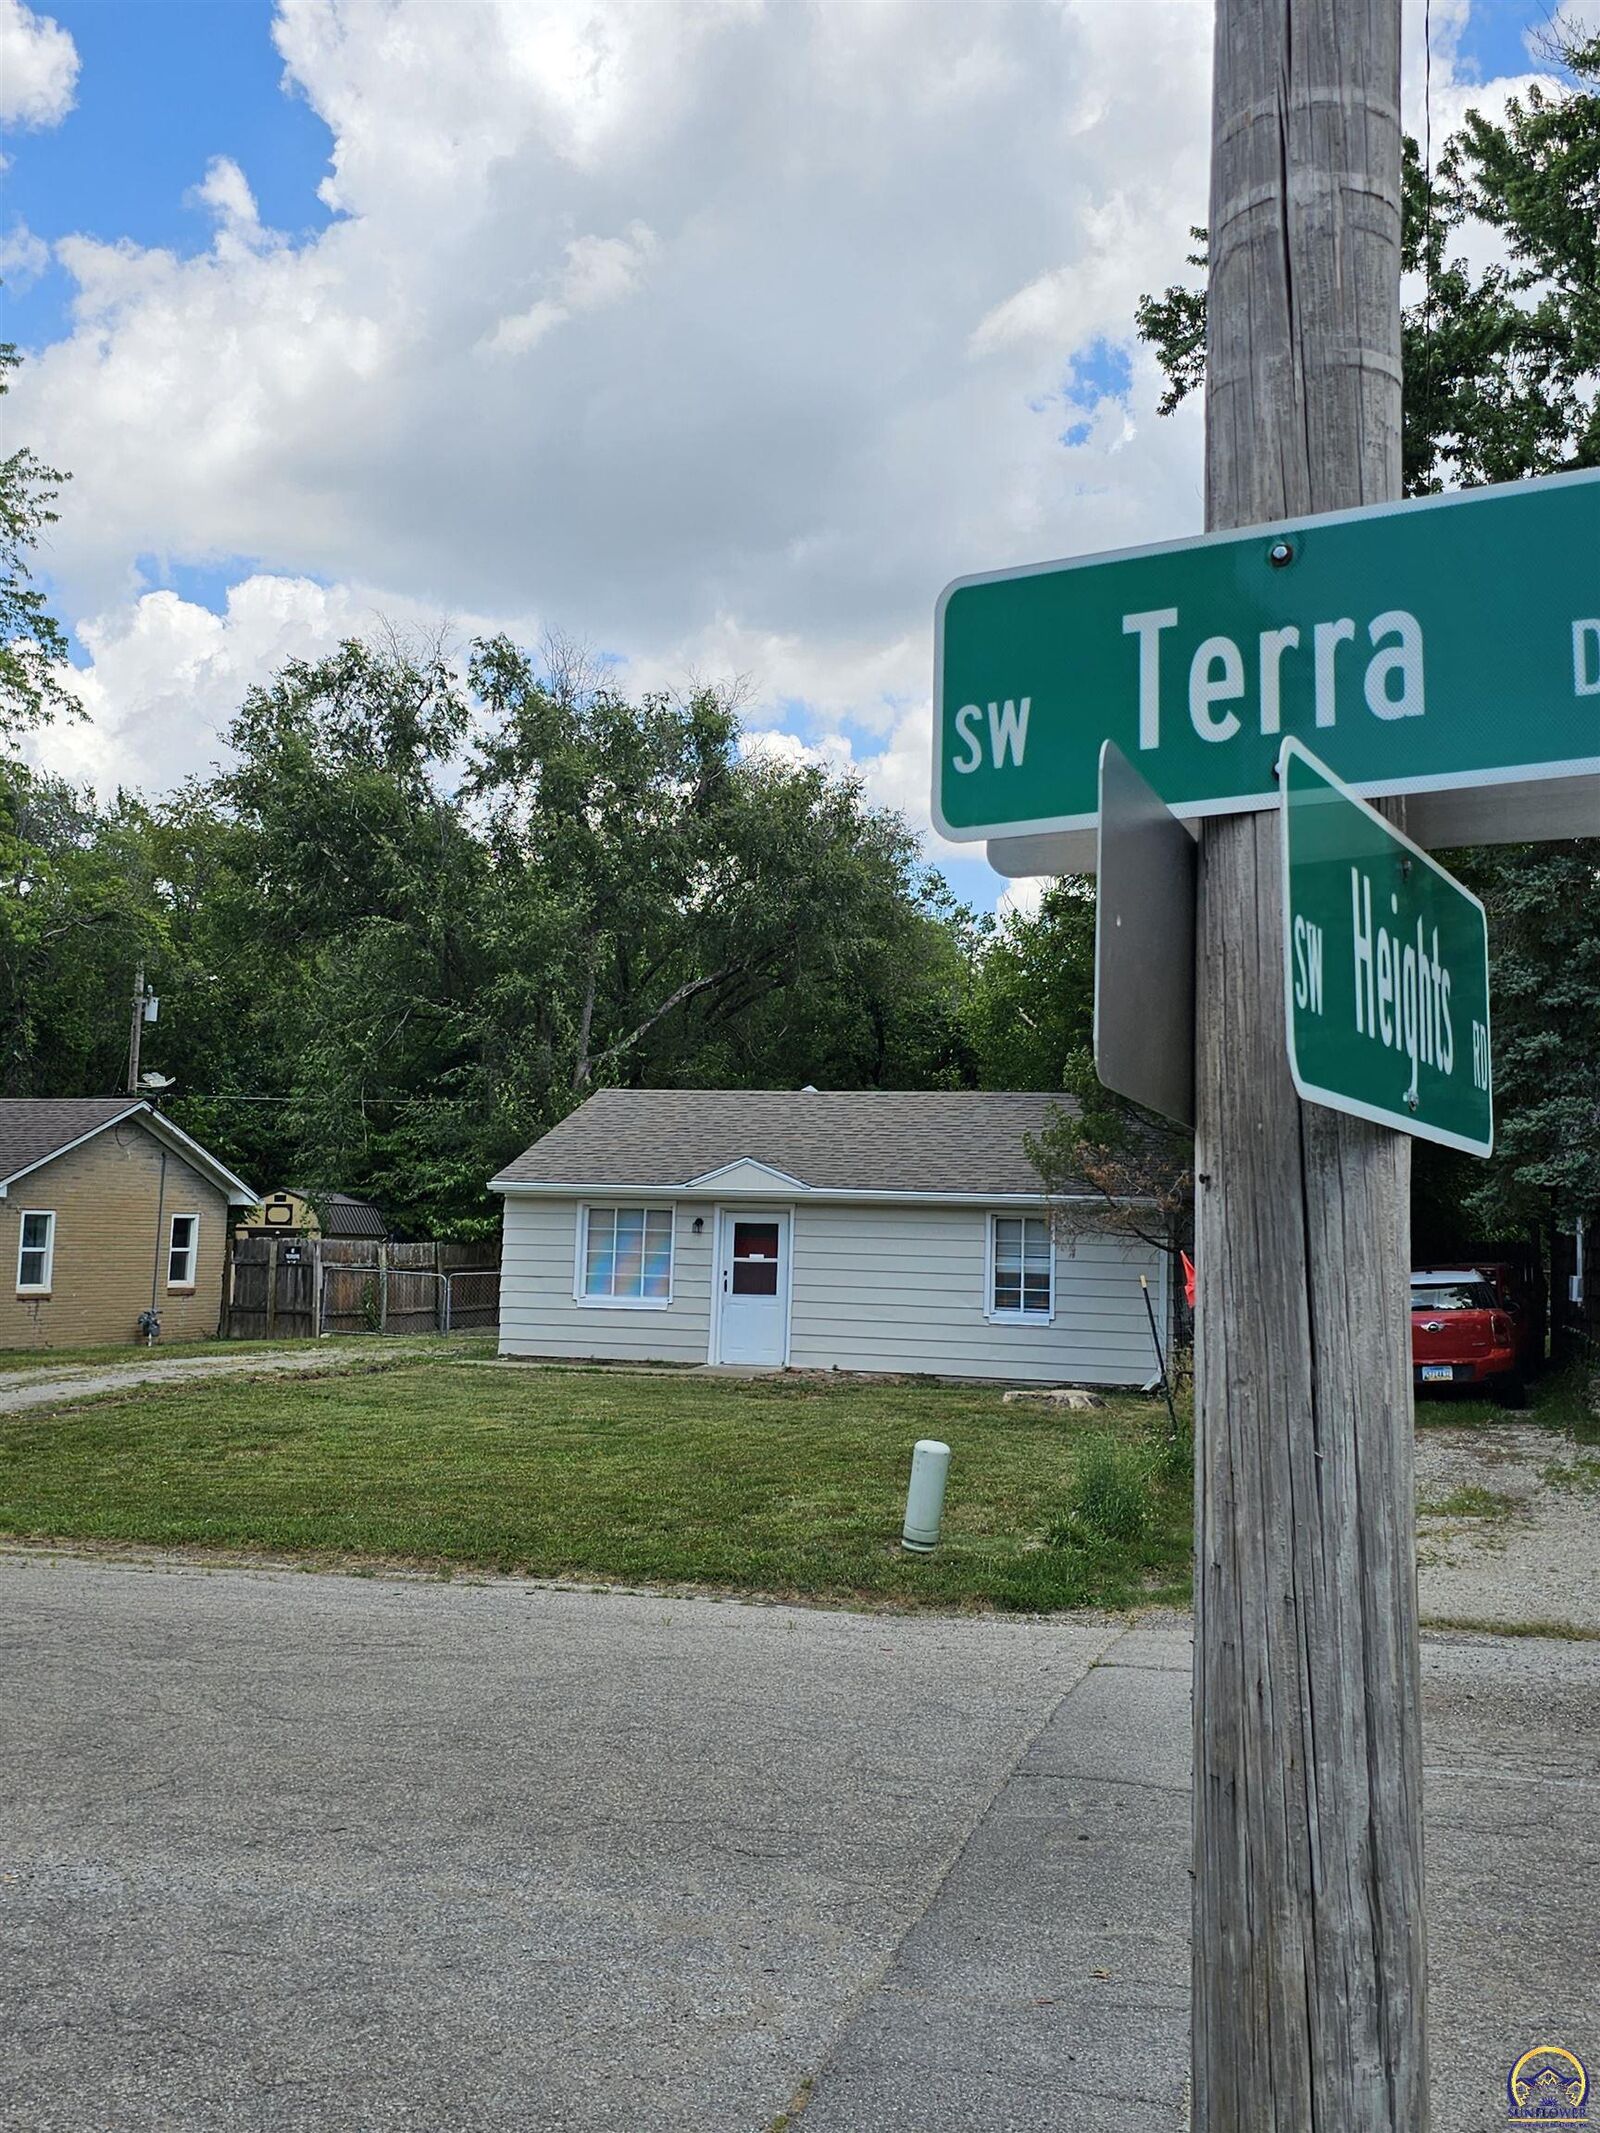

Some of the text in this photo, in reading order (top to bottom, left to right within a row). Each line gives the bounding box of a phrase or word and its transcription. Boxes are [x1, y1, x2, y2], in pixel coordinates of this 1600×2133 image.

[952, 697, 1031, 774] SW
[1122, 607, 1425, 750] Terra
[1295, 866, 1488, 1103] SW Heights RD
